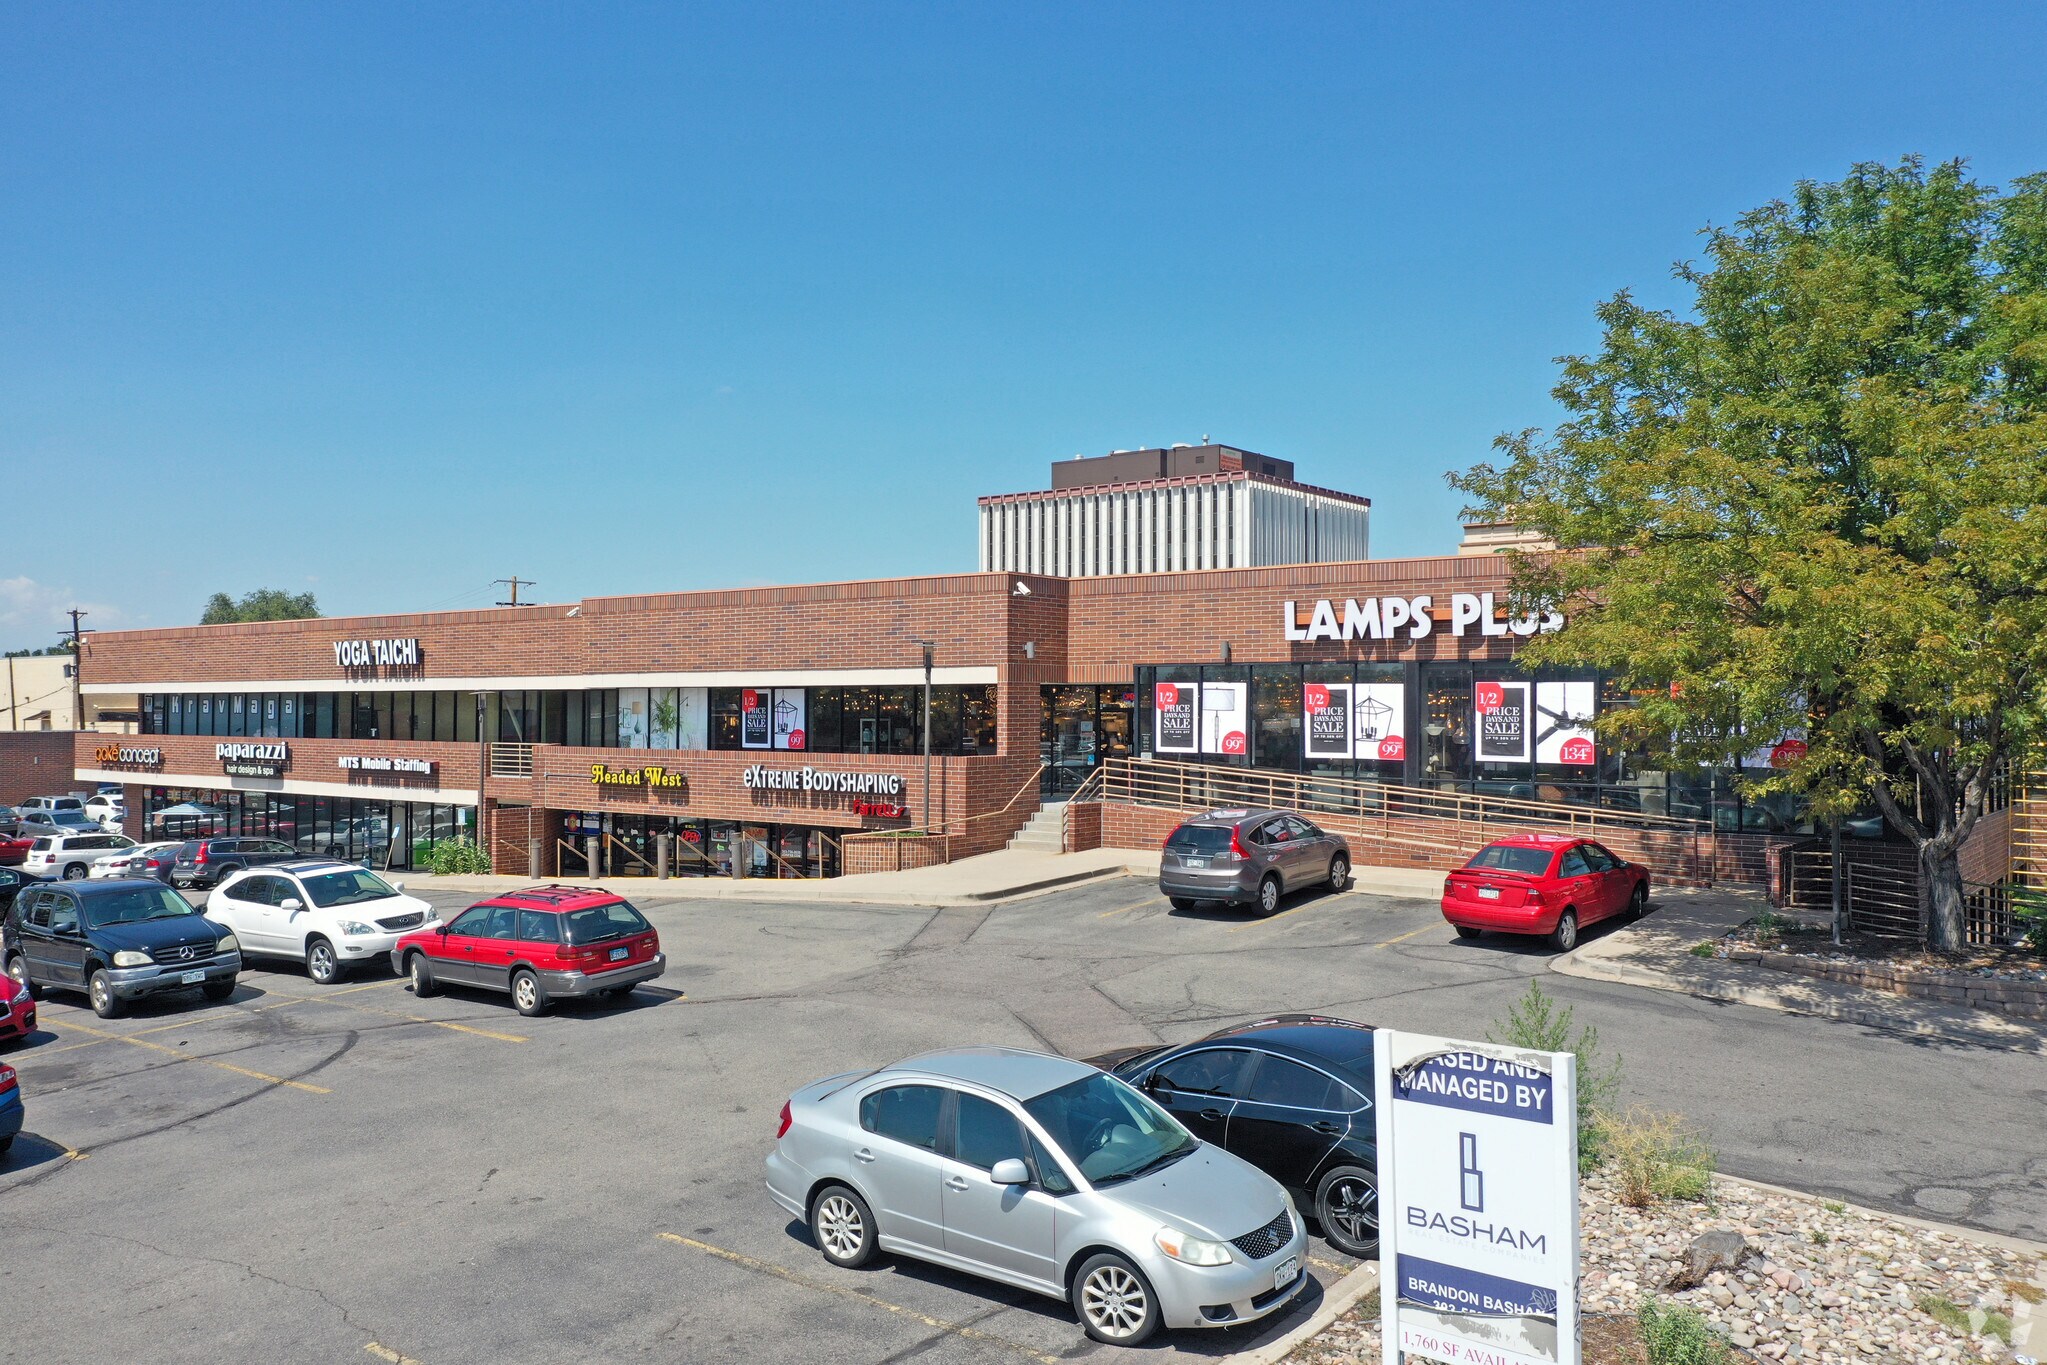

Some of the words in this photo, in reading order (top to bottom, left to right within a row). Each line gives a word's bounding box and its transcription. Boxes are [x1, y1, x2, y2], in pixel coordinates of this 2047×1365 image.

[1285, 596, 1432, 640] LAMPS
[333, 641, 370, 666] YOGA
[373, 639, 417, 665] TAICHI
[1159, 692, 1174, 704] 1/2
[1308, 693, 1324, 707] 1/2
[1479, 690, 1497, 707] 1/2
[1164, 704, 1190, 713] PRICE
[1314, 707, 1343, 715] PRICE
[1486, 706, 1520, 716] PRICE
[747, 719, 766, 728] SALE
[1163, 718, 1190, 728] SALE
[1313, 722, 1344, 732] SALE
[1485, 723, 1520, 734] SALE
[216, 741, 286, 761] paparazzi
[226, 764, 237, 773] hair
[237, 765, 257, 776] design
[262, 767, 274, 776] spa
[338, 757, 360, 769] MTS
[361, 757, 391, 770] Mobile
[393, 759, 430, 774] Staffing
[591, 764, 641, 785] Headed
[644, 766, 682, 786] West
[803, 766, 899, 794] BODYSHAPING
[1426, 1053, 1487, 1072] ASED
[1493, 1060, 1541, 1080] AND
[1516, 1085, 1547, 1110] BY
[1407, 1206, 1546, 1254] BASHAM
[1408, 1277, 1479, 1306] BRANDON
[1405, 1331, 1439, 1351] 1,760
[1443, 1342, 1460, 1357] SF
